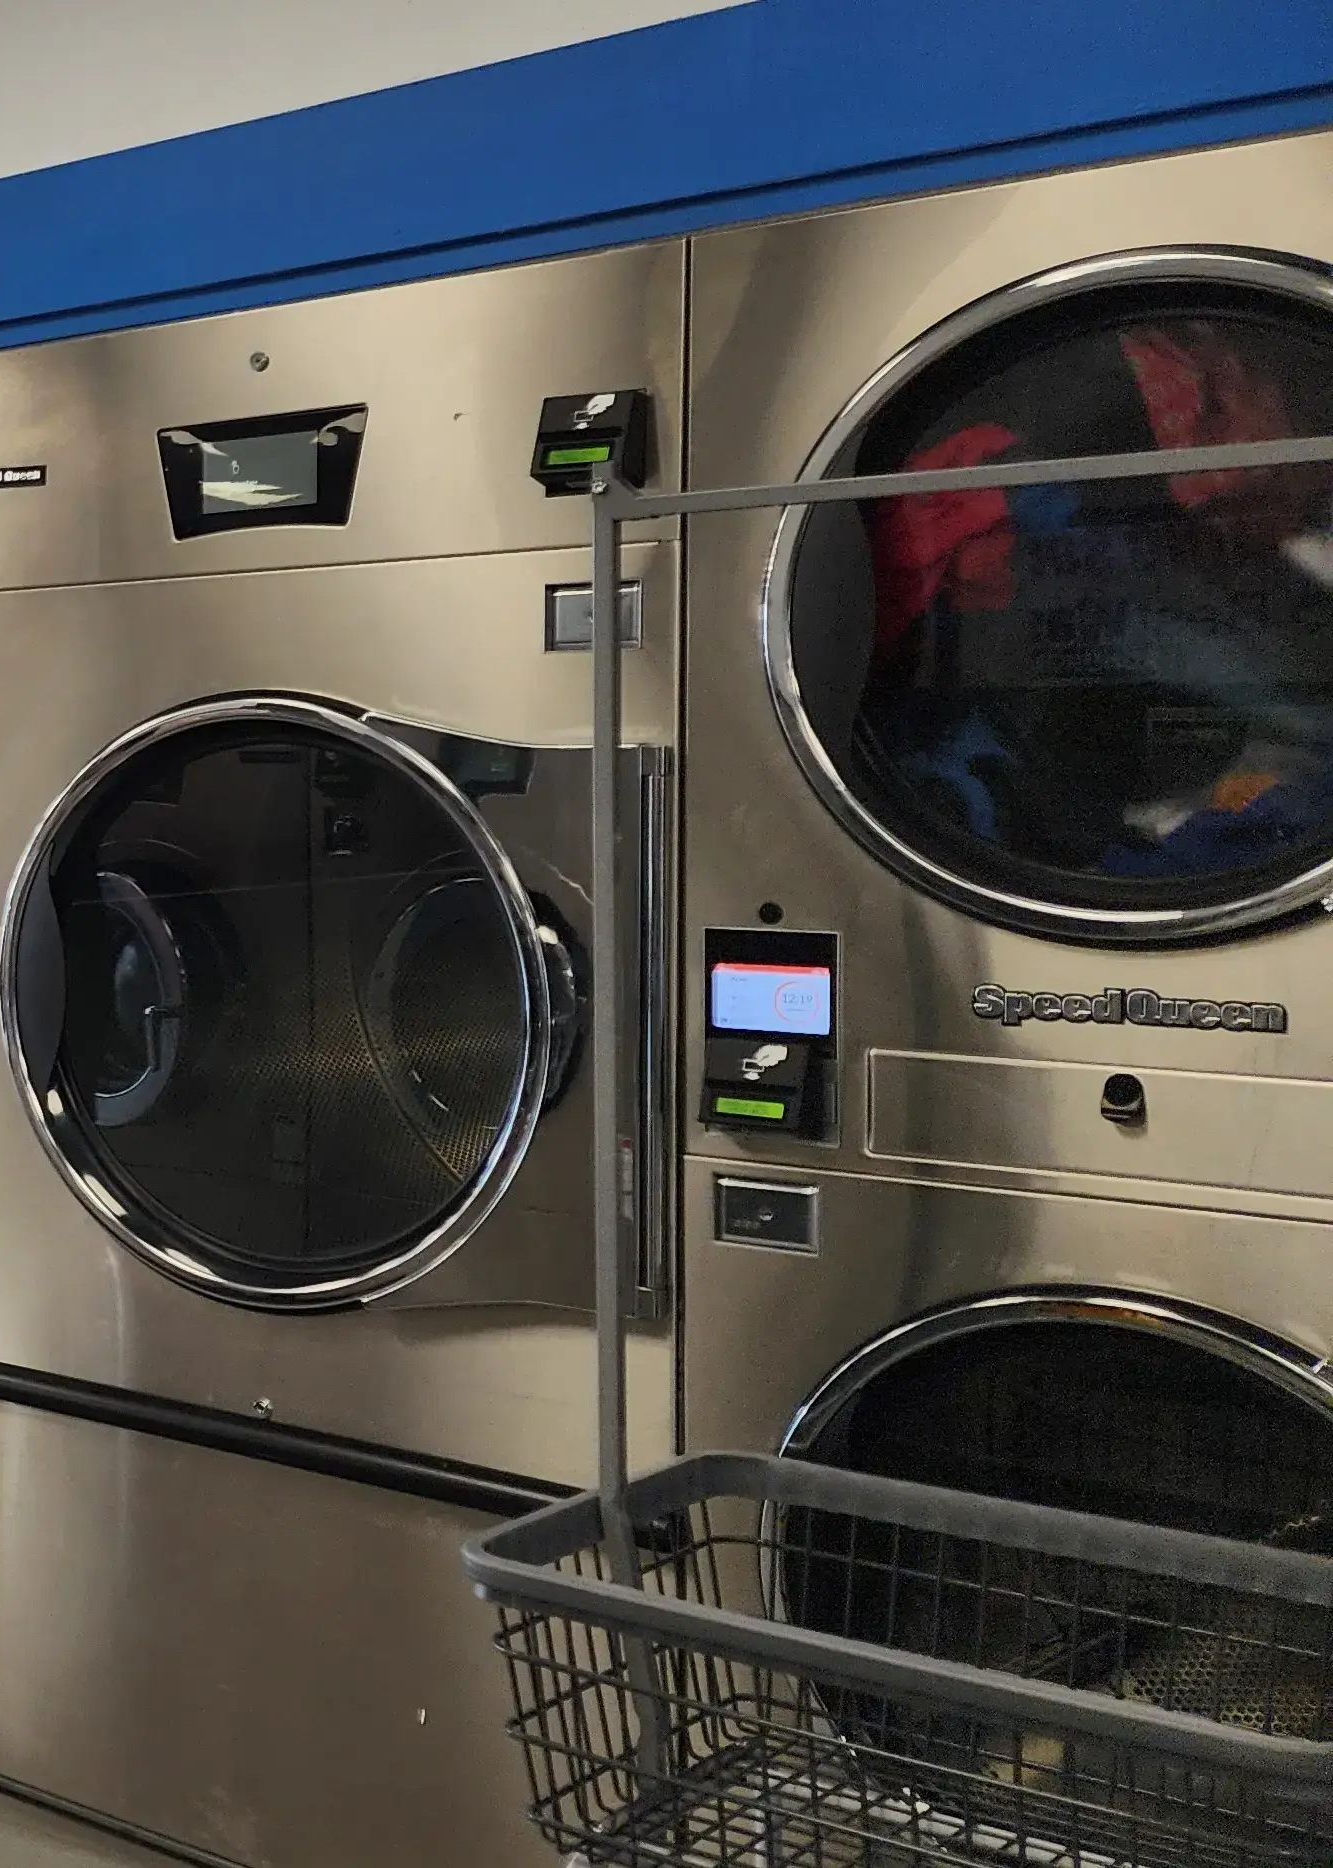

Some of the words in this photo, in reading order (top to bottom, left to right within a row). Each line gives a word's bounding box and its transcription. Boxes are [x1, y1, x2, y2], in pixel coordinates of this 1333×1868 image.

[3, 470, 41, 481] Queen
[973, 983, 1125, 1028] Speed
[1126, 988, 1289, 1034] Queen
